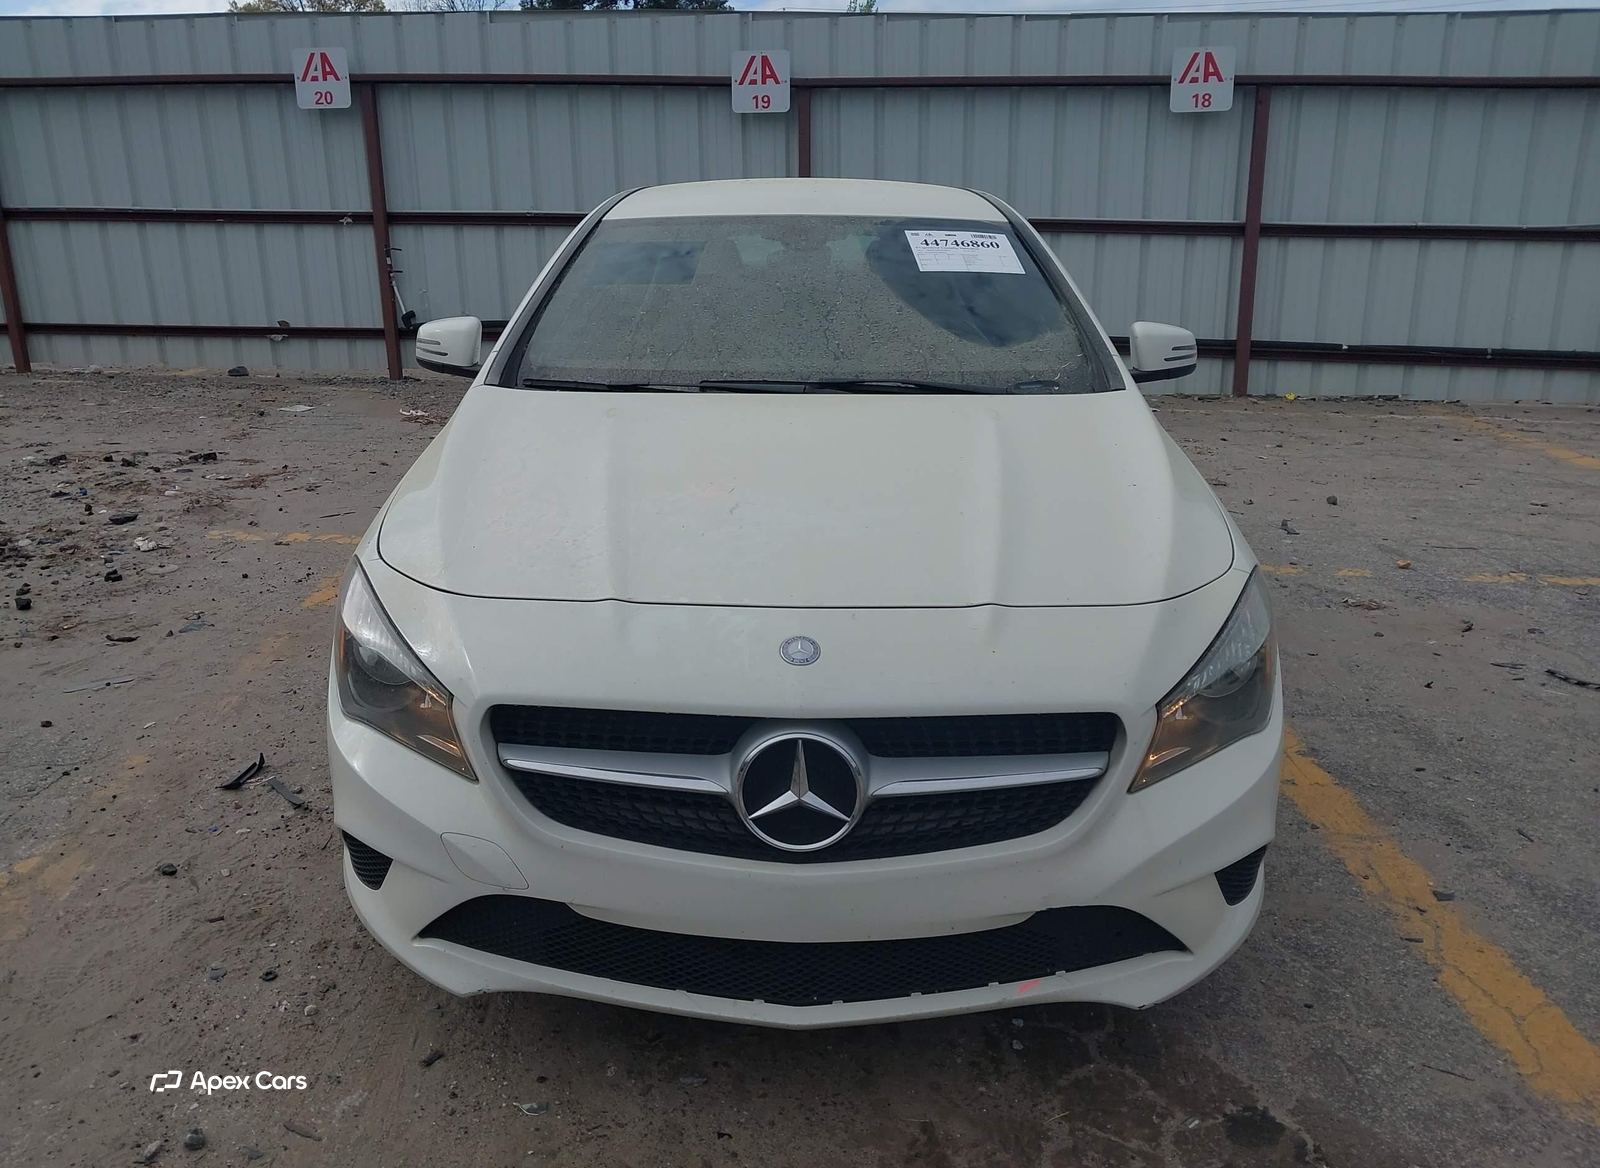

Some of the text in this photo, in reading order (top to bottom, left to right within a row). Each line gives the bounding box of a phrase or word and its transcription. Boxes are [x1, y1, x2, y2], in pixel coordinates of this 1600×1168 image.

[314, 91, 333, 105] 20
[752, 95, 771, 109] 19
[1192, 93, 1212, 108] 18
[920, 238, 1000, 249] 44746860
